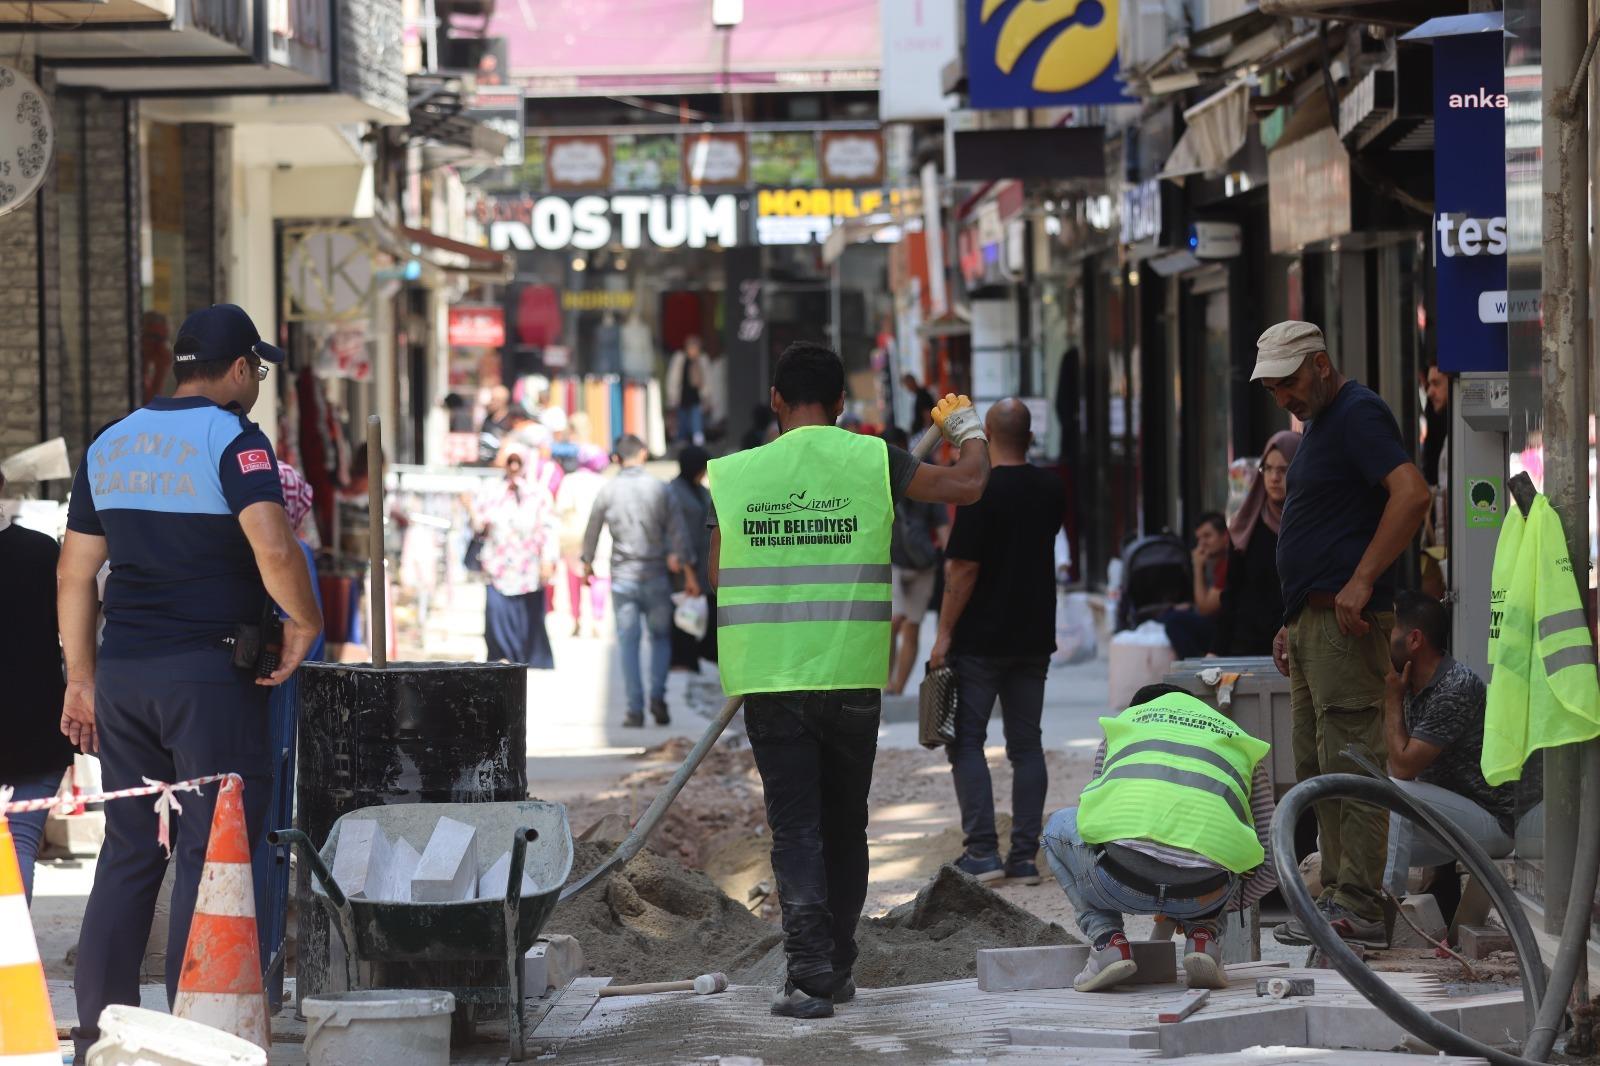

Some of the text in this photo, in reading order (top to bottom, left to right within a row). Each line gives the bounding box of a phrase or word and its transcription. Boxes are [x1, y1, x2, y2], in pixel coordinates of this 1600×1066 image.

[94, 469, 198, 497] ZABITA
[746, 501, 793, 513] Gülümse
[743, 515, 858, 535] İZMİT BELEDİYESİ
[750, 532, 852, 548] FEN İŞLERİ MÜDÜRLÜĞÜ
